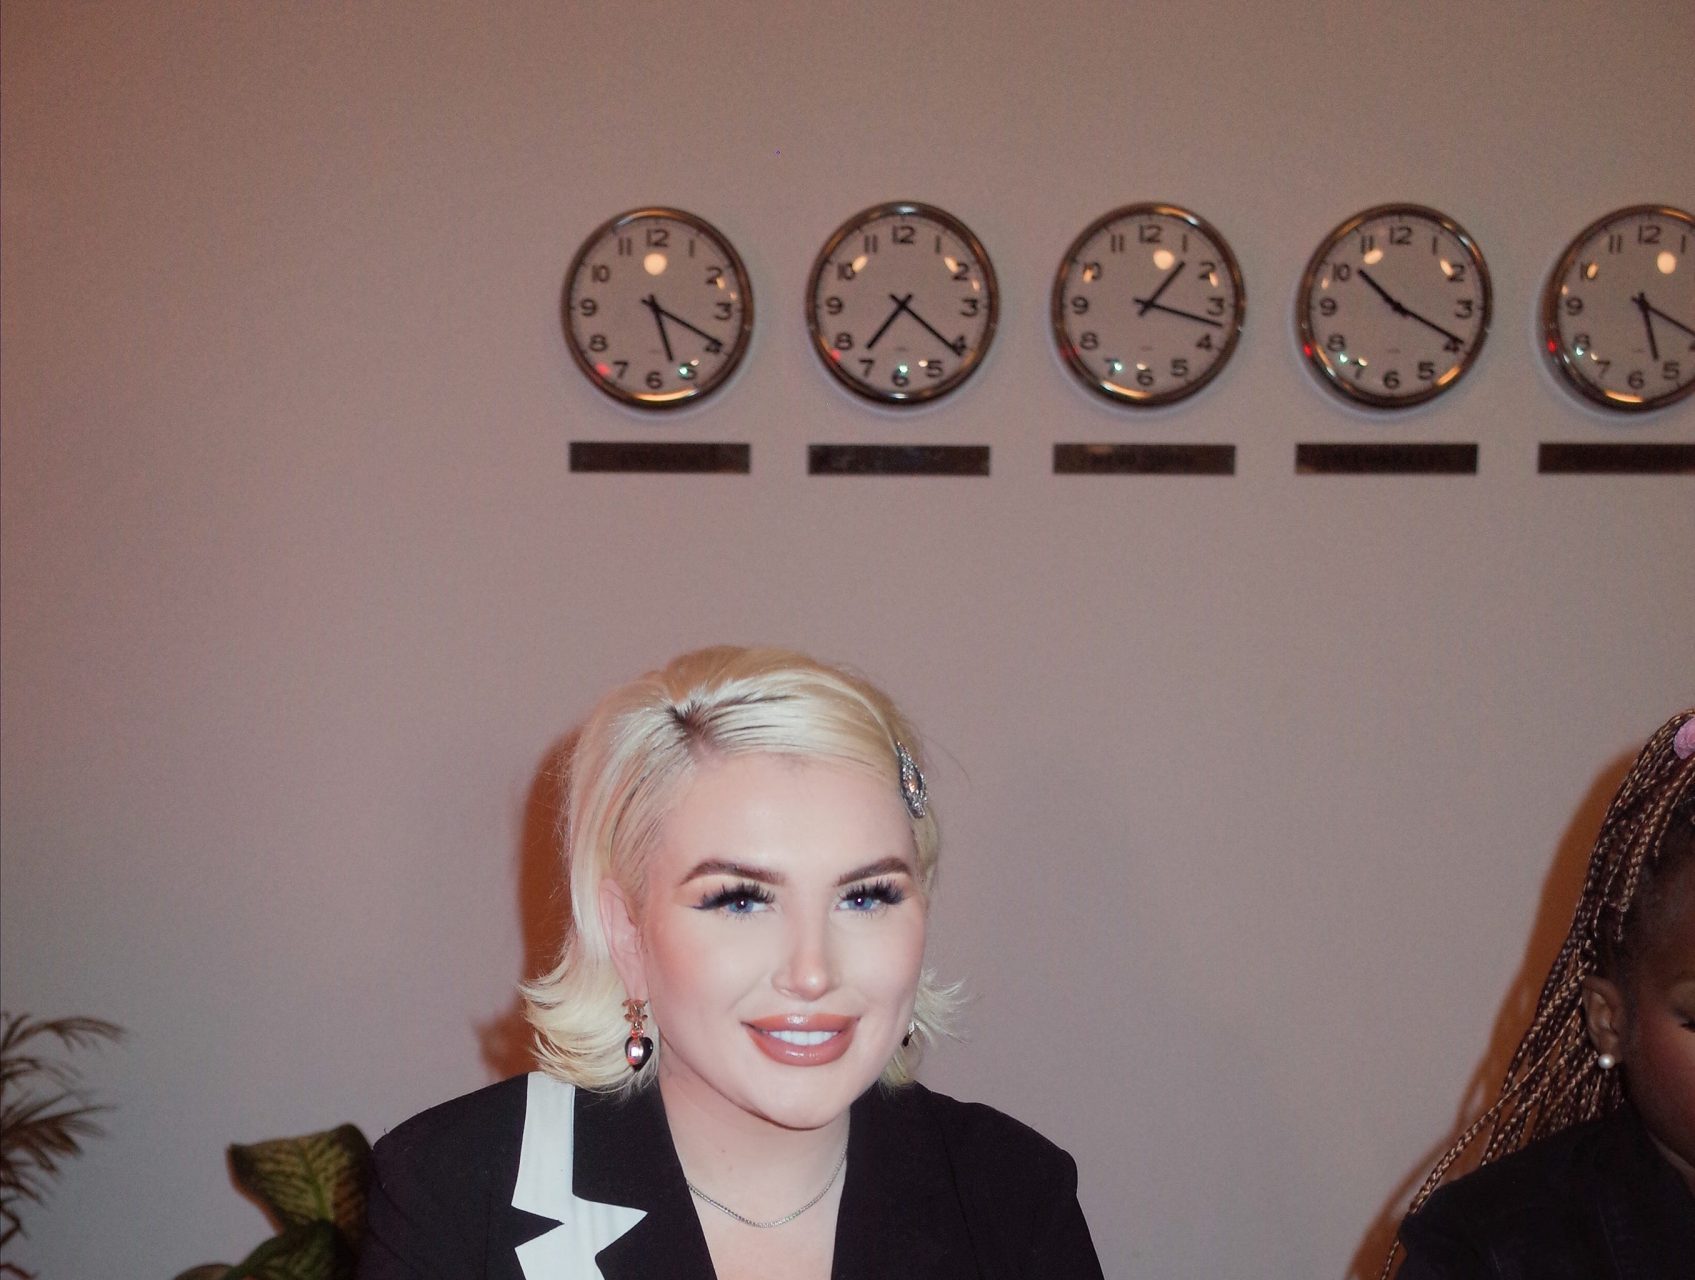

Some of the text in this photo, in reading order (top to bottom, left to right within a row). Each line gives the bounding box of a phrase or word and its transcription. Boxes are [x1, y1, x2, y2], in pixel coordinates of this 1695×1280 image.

[646, 229, 669, 247] 12
[892, 226, 915, 244] 12
[1139, 225, 1161, 243] 12
[1390, 226, 1412, 245] 12
[1638, 225, 1661, 244] 12
[618, 237, 632, 255] 11
[864, 235, 878, 252] 11
[1111, 234, 1124, 253] 11
[1360, 235, 1374, 253] 11
[1609, 235, 1622, 253] 11
[592, 265, 610, 281] 10
[706, 266, 723, 285] 2
[837, 263, 855, 280] 10
[953, 263, 968, 281] 2
[1199, 262, 1216, 281] 2
[1332, 263, 1350, 281] 10
[1447, 263, 1465, 282] 2
[580, 299, 597, 317] 9
[715, 302, 732, 320] 3
[826, 297, 842, 314] 9
[960, 299, 978, 316] 3
[1072, 296, 1088, 314] 9
[1207, 297, 1224, 315] 3
[1320, 298, 1336, 316] 9
[1455, 300, 1473, 318] 3
[1566, 297, 1583, 315] 9
[589, 335, 608, 352] 8
[835, 333, 853, 349] 8
[1080, 332, 1098, 349] 8
[1196, 334, 1212, 351] 4
[1327, 334, 1345, 351] 8
[613, 361, 628, 378] 7
[859, 359, 874, 377] 7
[892, 367, 909, 386] 6
[927, 360, 943, 377] 5
[1171, 359, 1188, 376] 5
[1418, 362, 1434, 379] 5
[1596, 360, 1610, 378] 7
[1663, 361, 1679, 380] 5
[646, 372, 663, 389] 6
[1136, 368, 1154, 386] 6
[1383, 371, 1400, 389] 6
[1628, 370, 1644, 389] 6
